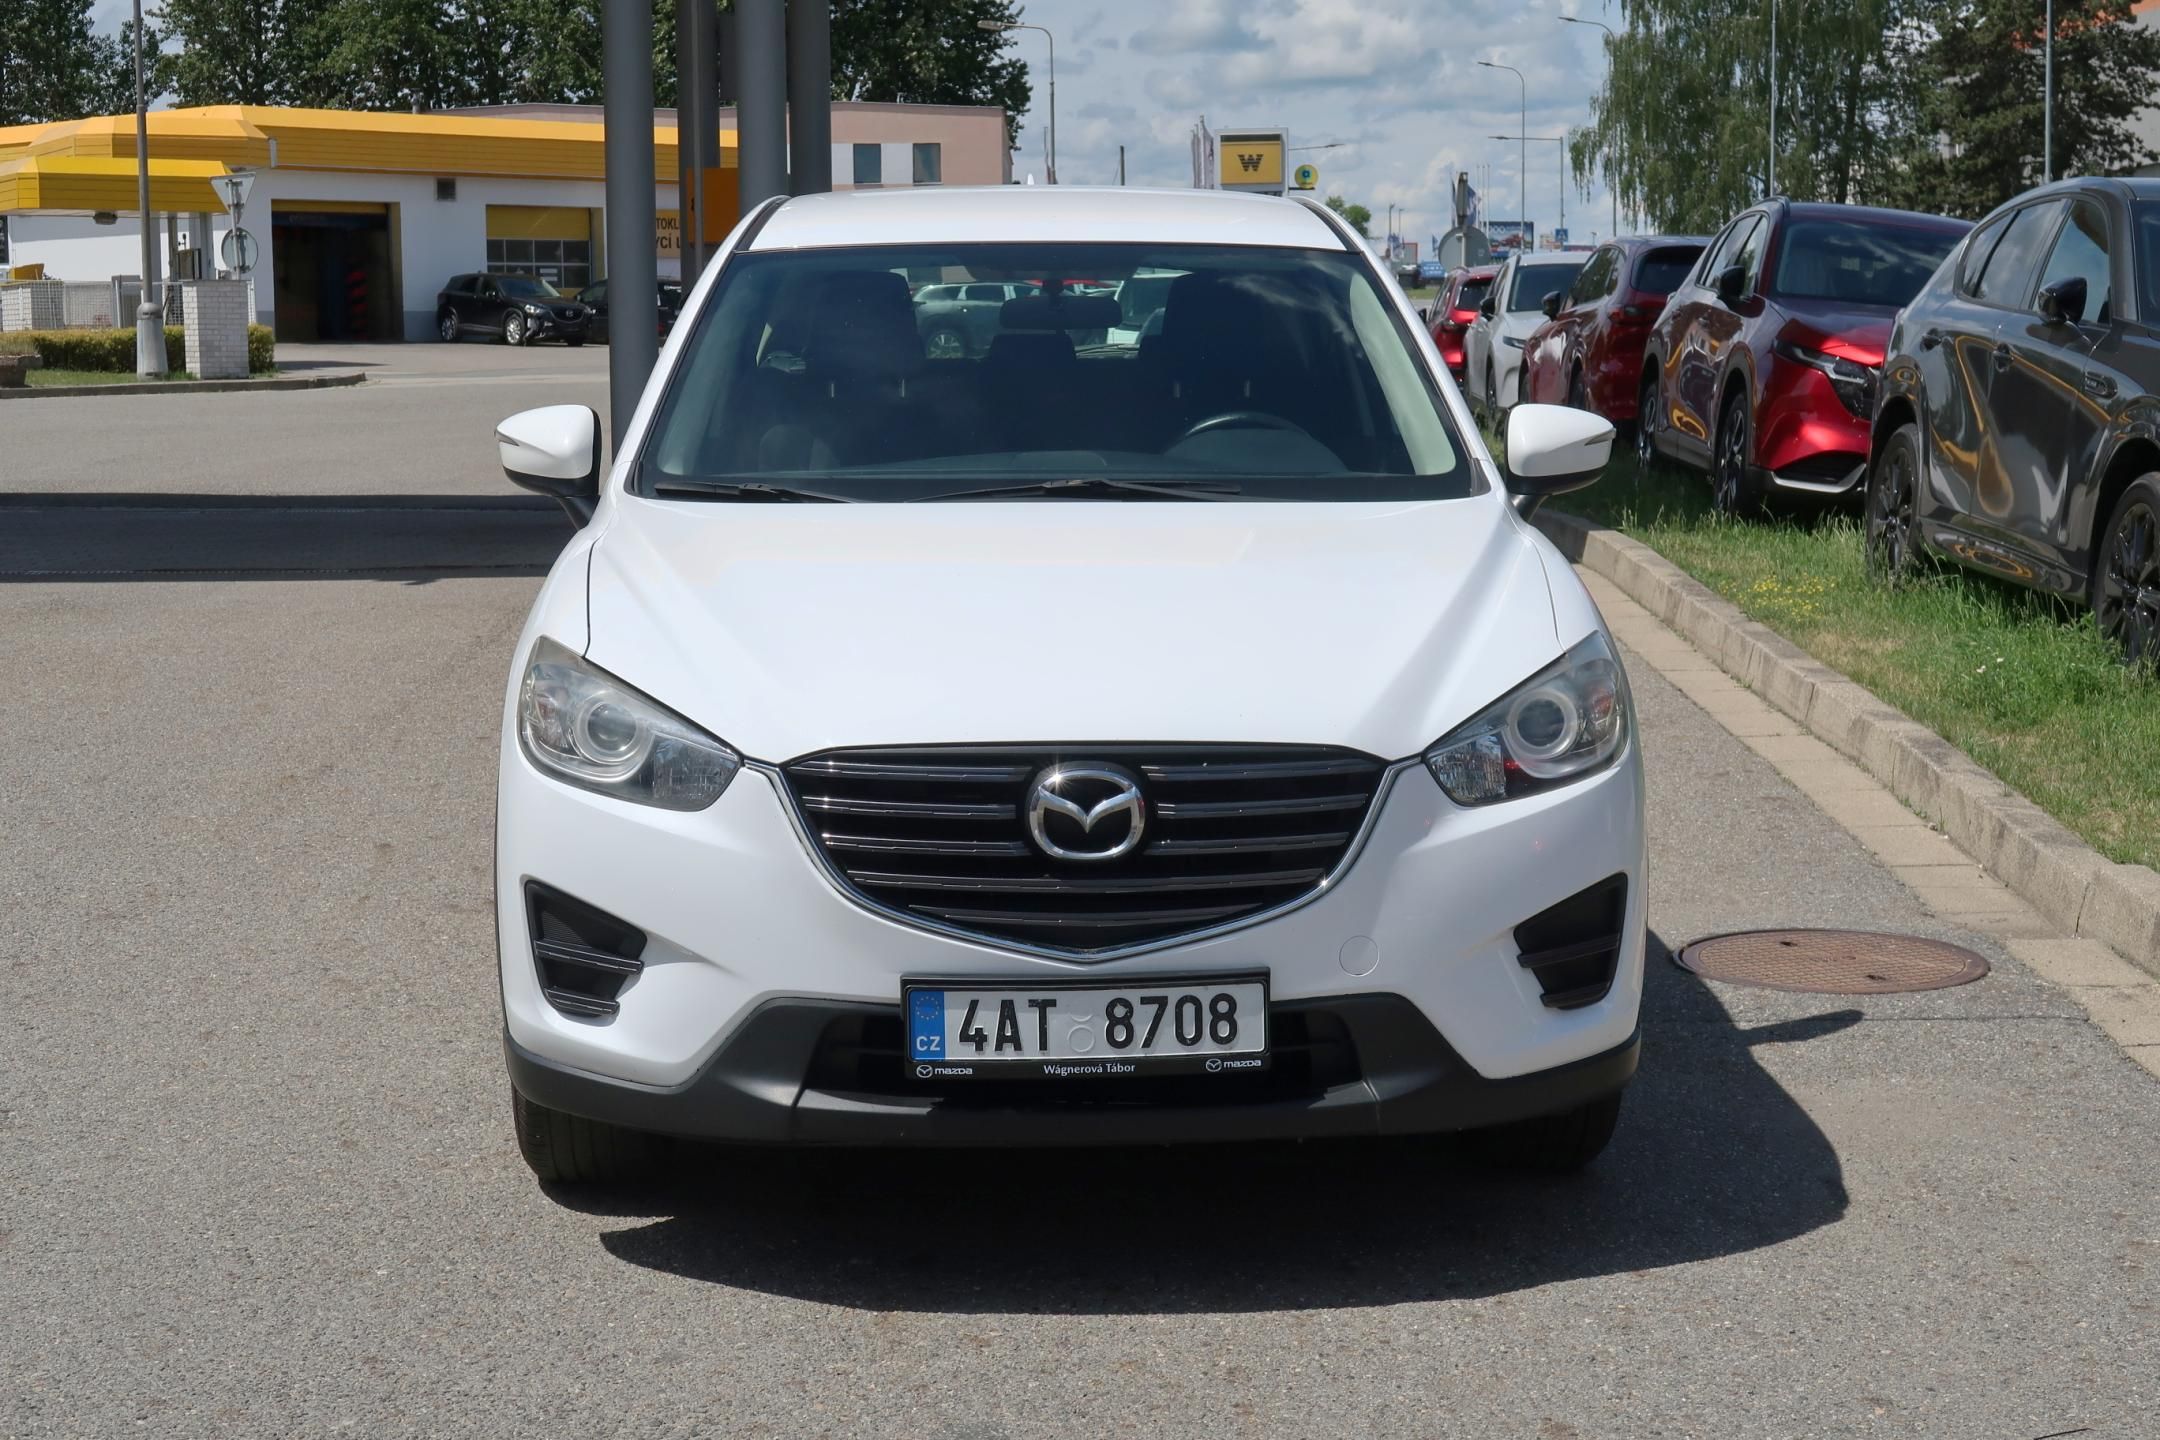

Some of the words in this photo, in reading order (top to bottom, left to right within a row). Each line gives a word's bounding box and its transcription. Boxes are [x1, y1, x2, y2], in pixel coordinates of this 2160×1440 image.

[959, 999, 1057, 1052] 4AT
[1105, 992, 1238, 1049] 8708
[916, 1036, 941, 1051] CZ
[1043, 1063, 1103, 1077] Wágnerová
[1106, 1062, 1136, 1074] Tábor
